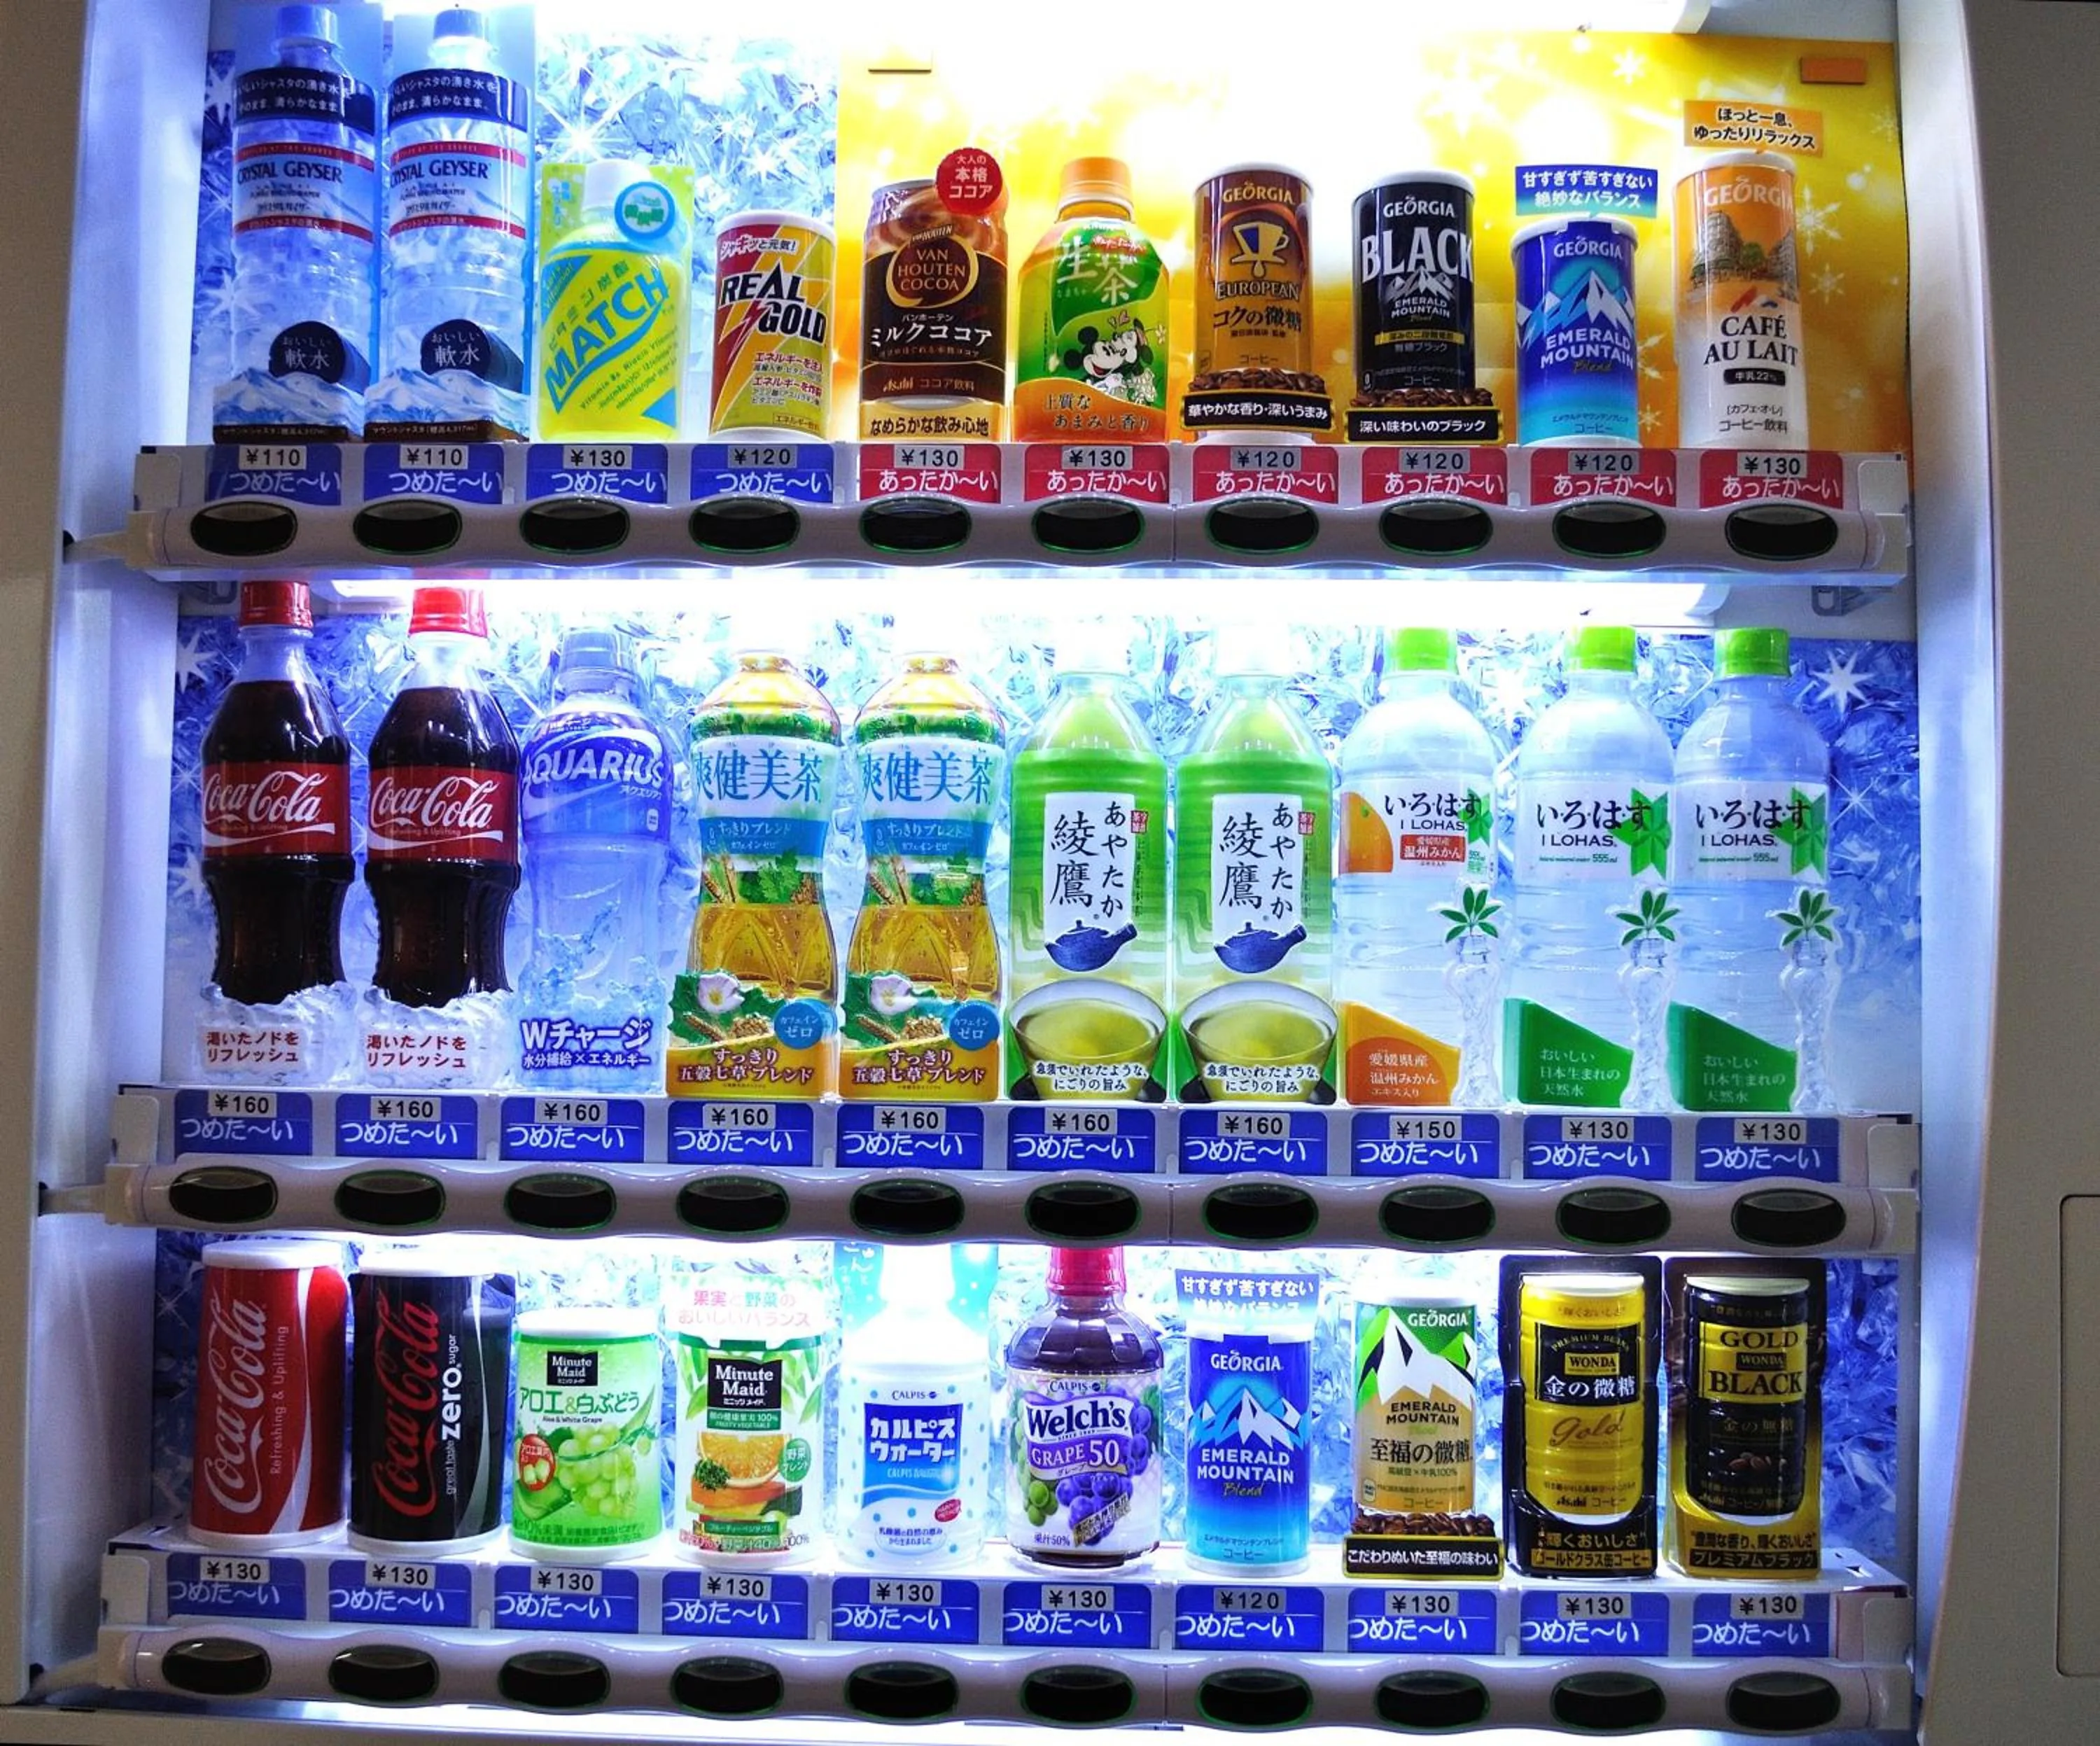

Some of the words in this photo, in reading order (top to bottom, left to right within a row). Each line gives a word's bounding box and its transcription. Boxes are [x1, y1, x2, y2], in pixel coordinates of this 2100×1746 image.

[1694, 125, 1815, 149] ゆったりリラックス
[428, 159, 489, 179] GEYSER
[958, 155, 986, 165] 大人の
[284, 160, 342, 181] GEYSER
[955, 167, 988, 183] 本格
[949, 185, 993, 200] ココア
[916, 249, 948, 261] VAN
[1362, 227, 1473, 283] BLACK
[898, 263, 965, 277] HOUTEN
[722, 262, 806, 305] REAL
[900, 279, 960, 291] COCOA
[1217, 280, 1300, 302] EUROPEAN
[1395, 296, 1447, 308] EMERALD
[1392, 306, 1450, 319] MOUNTAIN
[758, 302, 827, 343] GOLD
[1722, 315, 1786, 339] CAFÉ
[432, 331, 480, 343] おいしい
[545, 266, 670, 414] MATCH
[872, 323, 992, 347] ミルクココア
[1546, 328, 1631, 351] EMERALD
[285, 351, 330, 369] 軟水
[435, 348, 480, 368] 軟水
[1541, 346, 1634, 370] MOUNTAIN
[1704, 343, 1743, 365] AU
[1747, 342, 1798, 367] LAIT
[871, 415, 988, 436] なめらかな飲み心地
[1054, 414, 1149, 431] あまみと香り
[1360, 420, 1485, 433] 深い味わいのブラック
[1720, 419, 1787, 433] コーヒー飲料
[246, 448, 300, 466] ¥110
[407, 448, 463, 466] ¥110
[570, 449, 626, 467] ¥130
[734, 447, 791, 465] ¥120
[901, 449, 959, 466] ¥130
[1069, 449, 1126, 467] ¥130
[1237, 450, 1295, 467] ¥120
[1405, 452, 1464, 470] ¥120
[1574, 454, 1632, 471] ¥120
[1743, 456, 1801, 475] ¥130
[696, 748, 822, 804] 爽健美茶
[862, 750, 993, 805] 爽健美茶
[203, 770, 328, 825] Coca-Cola
[370, 775, 500, 829] Coca-Cola
[1411, 820, 1465, 831] LOHAS
[1550, 834, 1614, 847] LOHAS
[1711, 834, 1775, 847] LOHAS
[1050, 810, 1099, 907] 綾鷹
[1100, 801, 1128, 919] あやたか
[1219, 811, 1268, 909] 綾鷹
[1270, 802, 1296, 919] あやたか
[1404, 846, 1461, 859] 温州みかん
[206, 1031, 299, 1046] 渇いたノドを
[367, 1033, 466, 1050] 渇いたノドを
[522, 1019, 652, 1050] Wチャージ
[785, 1026, 813, 1039] ゼロ
[958, 1028, 983, 1040] ゼロ
[207, 1047, 298, 1063] リフレッシュ
[367, 1052, 466, 1068] リフレッシュ
[713, 1049, 778, 1065] すっきり
[888, 1050, 952, 1066] すっきり
[1368, 1053, 1428, 1067] 愛媛県産
[1541, 1049, 1595, 1062] おいしい
[1703, 1055, 1758, 1068] おいしい
[1370, 1071, 1438, 1085] 温州みかん
[1541, 1067, 1620, 1081] 日本生まれの
[1702, 1072, 1786, 1086] 日本生まれの
[1054, 1078, 1127, 1091] にごりの旨み
[1225, 1079, 1299, 1094] にごりの旨み
[1543, 1083, 1584, 1097] 天然水
[215, 1095, 269, 1113] ¥160
[1706, 1089, 1748, 1102] 天然水
[378, 1101, 433, 1118] ¥160
[545, 1103, 601, 1121] ¥160
[712, 1108, 769, 1125] ¥160
[882, 1110, 939, 1129] ¥160
[1052, 1112, 1110, 1131] ¥160
[1225, 1116, 1283, 1134] ¥160
[1397, 1120, 1455, 1140] ¥150
[1570, 1121, 1628, 1139] ¥130
[1742, 1122, 1800, 1140] ¥130
[449, 1334, 458, 1364] sugar
[1721, 1332, 1798, 1348] GOLD
[552, 1356, 592, 1367] Minute
[1569, 1356, 1616, 1368] WONDA
[1741, 1355, 1784, 1367] WONDA
[556, 1367, 586, 1378] Maid
[715, 1365, 774, 1381] Minute
[722, 1382, 764, 1397] Maid
[1050, 1381, 1088, 1392] CALPIS
[1544, 1376, 1635, 1399] 金の微糖
[1709, 1371, 1803, 1395] BLACK
[204, 1286, 266, 1514] Coca-Cola
[373, 1288, 440, 1516] Coca-Cola
[442, 1367, 463, 1441] zero
[892, 1390, 925, 1400] CALPIS
[1391, 1402, 1456, 1413] EMERALD
[1026, 1399, 1126, 1438] Welch's
[1387, 1413, 1460, 1425] MOUNTAIN
[870, 1418, 955, 1439] カルピス
[270, 1406, 288, 1474] Refreshing
[870, 1440, 955, 1462] ウォーター
[1032, 1444, 1084, 1466] GRAPE
[1089, 1439, 1119, 1466] 50
[1202, 1449, 1290, 1465] EMERALD
[1371, 1438, 1470, 1464] 至福の微糖
[1198, 1466, 1294, 1483] MOUNTAIN
[1224, 1549, 1264, 1560] コーヒー
[1348, 1550, 1498, 1566] こだわりぬいた至福の味わい
[1693, 1551, 1814, 1567] プレミアムブラック
[207, 1562, 261, 1580] ¥130
[372, 1565, 428, 1586] ¥130
[538, 1571, 594, 1591] ¥130
[707, 1577, 764, 1598] ¥130
[876, 1583, 934, 1602] ¥130
[1049, 1589, 1107, 1608] ¥130
[1221, 1591, 1280, 1609] ¥120
[1392, 1594, 1450, 1614] ¥130
[1565, 1597, 1624, 1615] ¥130
[1740, 1596, 1798, 1614] ¥130
